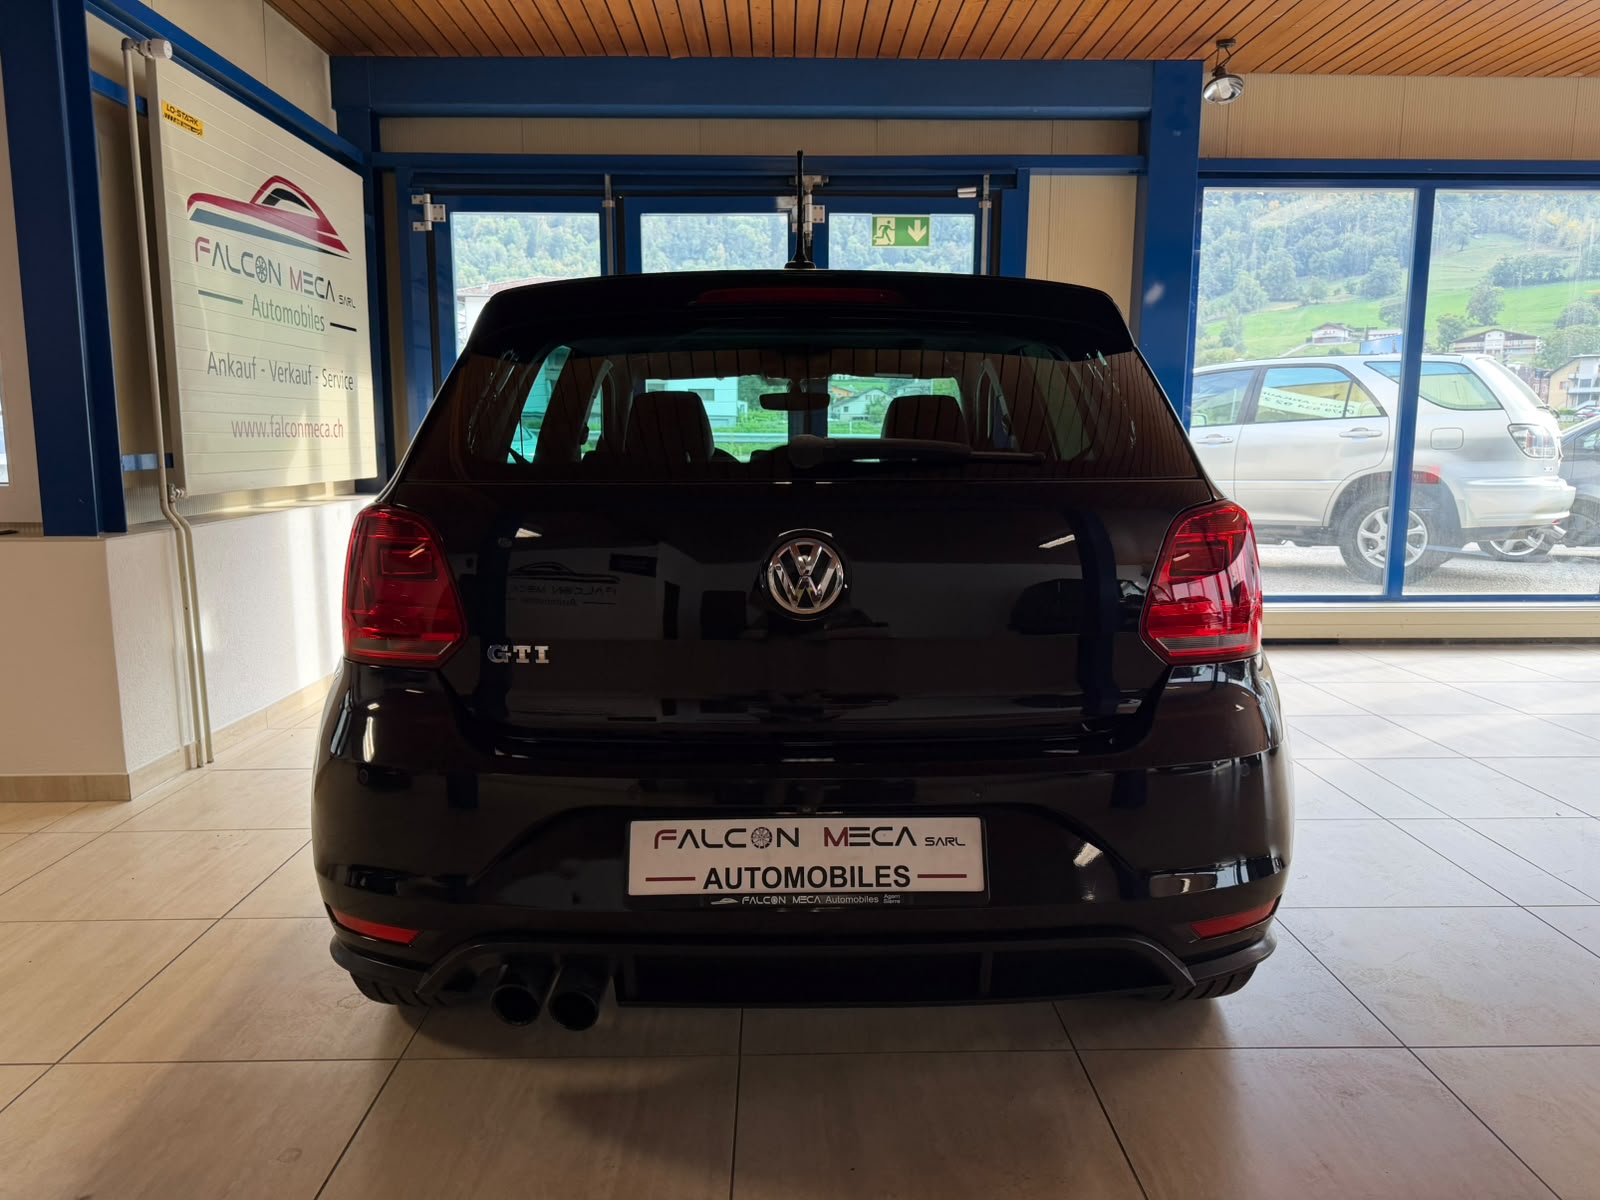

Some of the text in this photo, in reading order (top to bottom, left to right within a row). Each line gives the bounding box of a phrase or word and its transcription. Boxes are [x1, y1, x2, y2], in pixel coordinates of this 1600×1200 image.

[194, 236, 282, 287] FALCON
[289, 266, 335, 302] MECA
[251, 293, 325, 332] Automobiles
[207, 351, 257, 380] Ankauf
[269, 360, 312, 386] Verkauf
[321, 368, 354, 391] Service
[231, 414, 344, 439] www.falconmeca.ch
[487, 644, 550, 664] GTI
[654, 826, 966, 850] FALCON MECA SARL
[702, 865, 911, 890] AUTOMOBILES
[741, 894, 879, 905] FALCON MECA Automobiles
